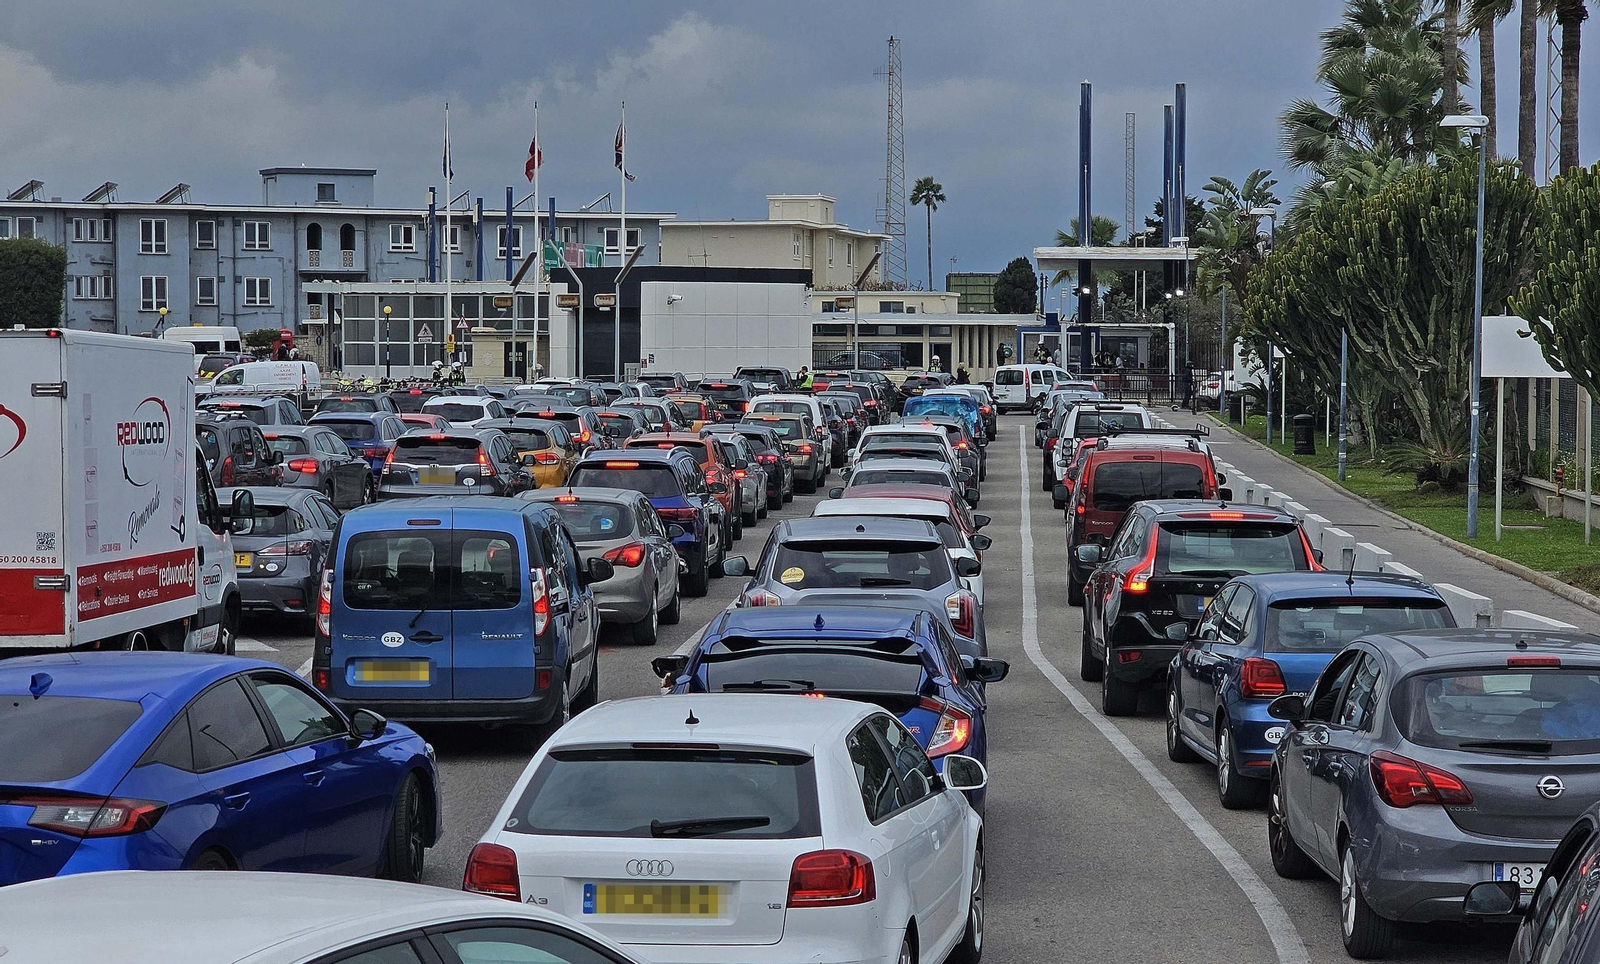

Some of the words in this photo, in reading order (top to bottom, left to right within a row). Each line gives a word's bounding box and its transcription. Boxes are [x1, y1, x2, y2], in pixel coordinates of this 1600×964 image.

[11, 555, 28, 564] 200
[29, 556, 57, 564] 45818
[158, 557, 195, 588] redwood.gi
[81, 573, 98, 586] Removals
[383, 635, 403, 644] GBZ
[1267, 731, 1284, 739] GB
[1509, 866, 1545, 885] 83
[525, 894, 549, 905] A3
